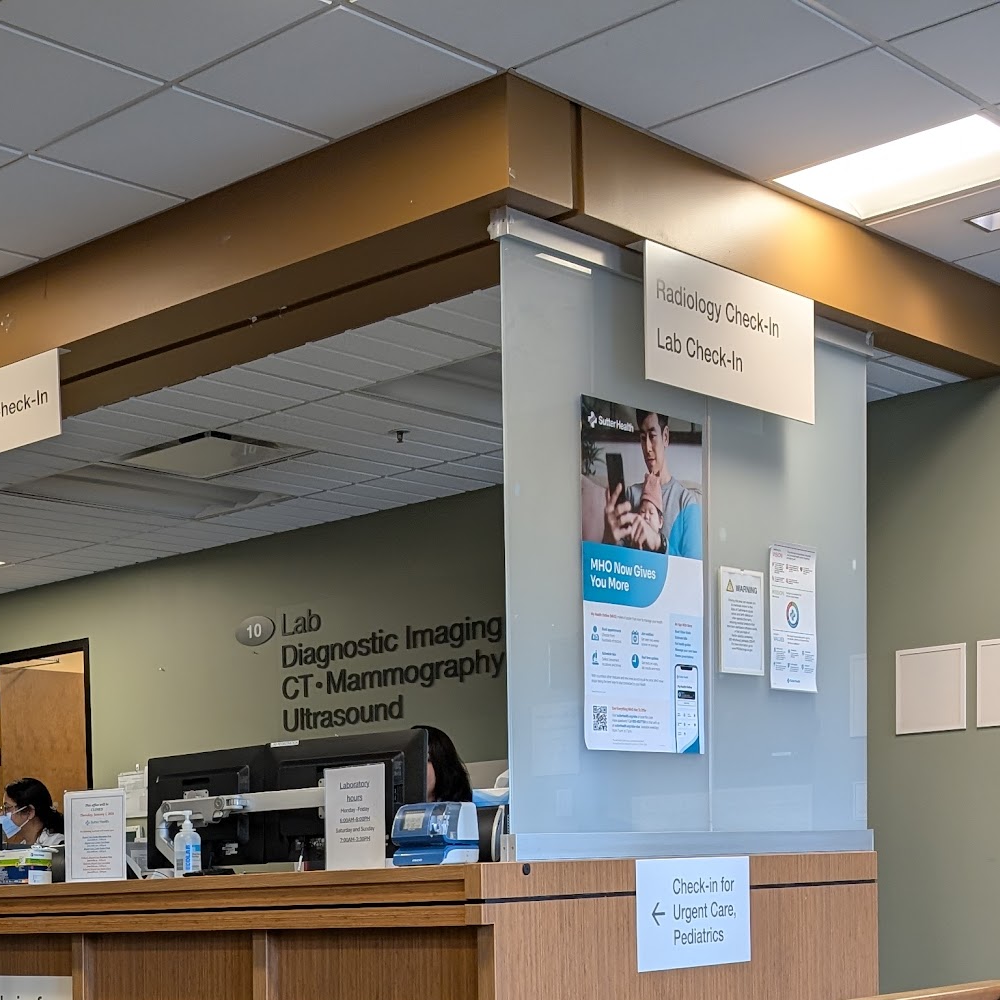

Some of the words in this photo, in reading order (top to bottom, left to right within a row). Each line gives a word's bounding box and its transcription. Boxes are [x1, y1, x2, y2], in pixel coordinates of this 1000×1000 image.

[656, 278, 722, 323] Radiology
[725, 302, 780, 339] Check-In
[657, 327, 682, 354] Lab
[686, 337, 743, 373] Check-In
[590, 557, 612, 573] MHO
[614, 561, 632, 576] Now
[633, 564, 656, 579] Gives
[590, 574, 607, 589] You
[608, 578, 629, 591] More
[735, 584, 758, 595] WARNING
[246, 623, 262, 639] 10
[281, 609, 322, 636] Lab
[281, 629, 399, 669] Diagnostic
[405, 616, 502, 649] Imaging
[281, 673, 314, 700] CT
[326, 649, 506, 695] Mammography
[282, 695, 404, 733] Ultrasound
[340, 780, 370, 790] Laboratory
[672, 877, 718, 895] Check-in
[721, 876, 735, 892] for
[673, 903, 708, 923] Urgent
[710, 901, 737, 919] Care,
[673, 927, 724, 946] Pediatrics
